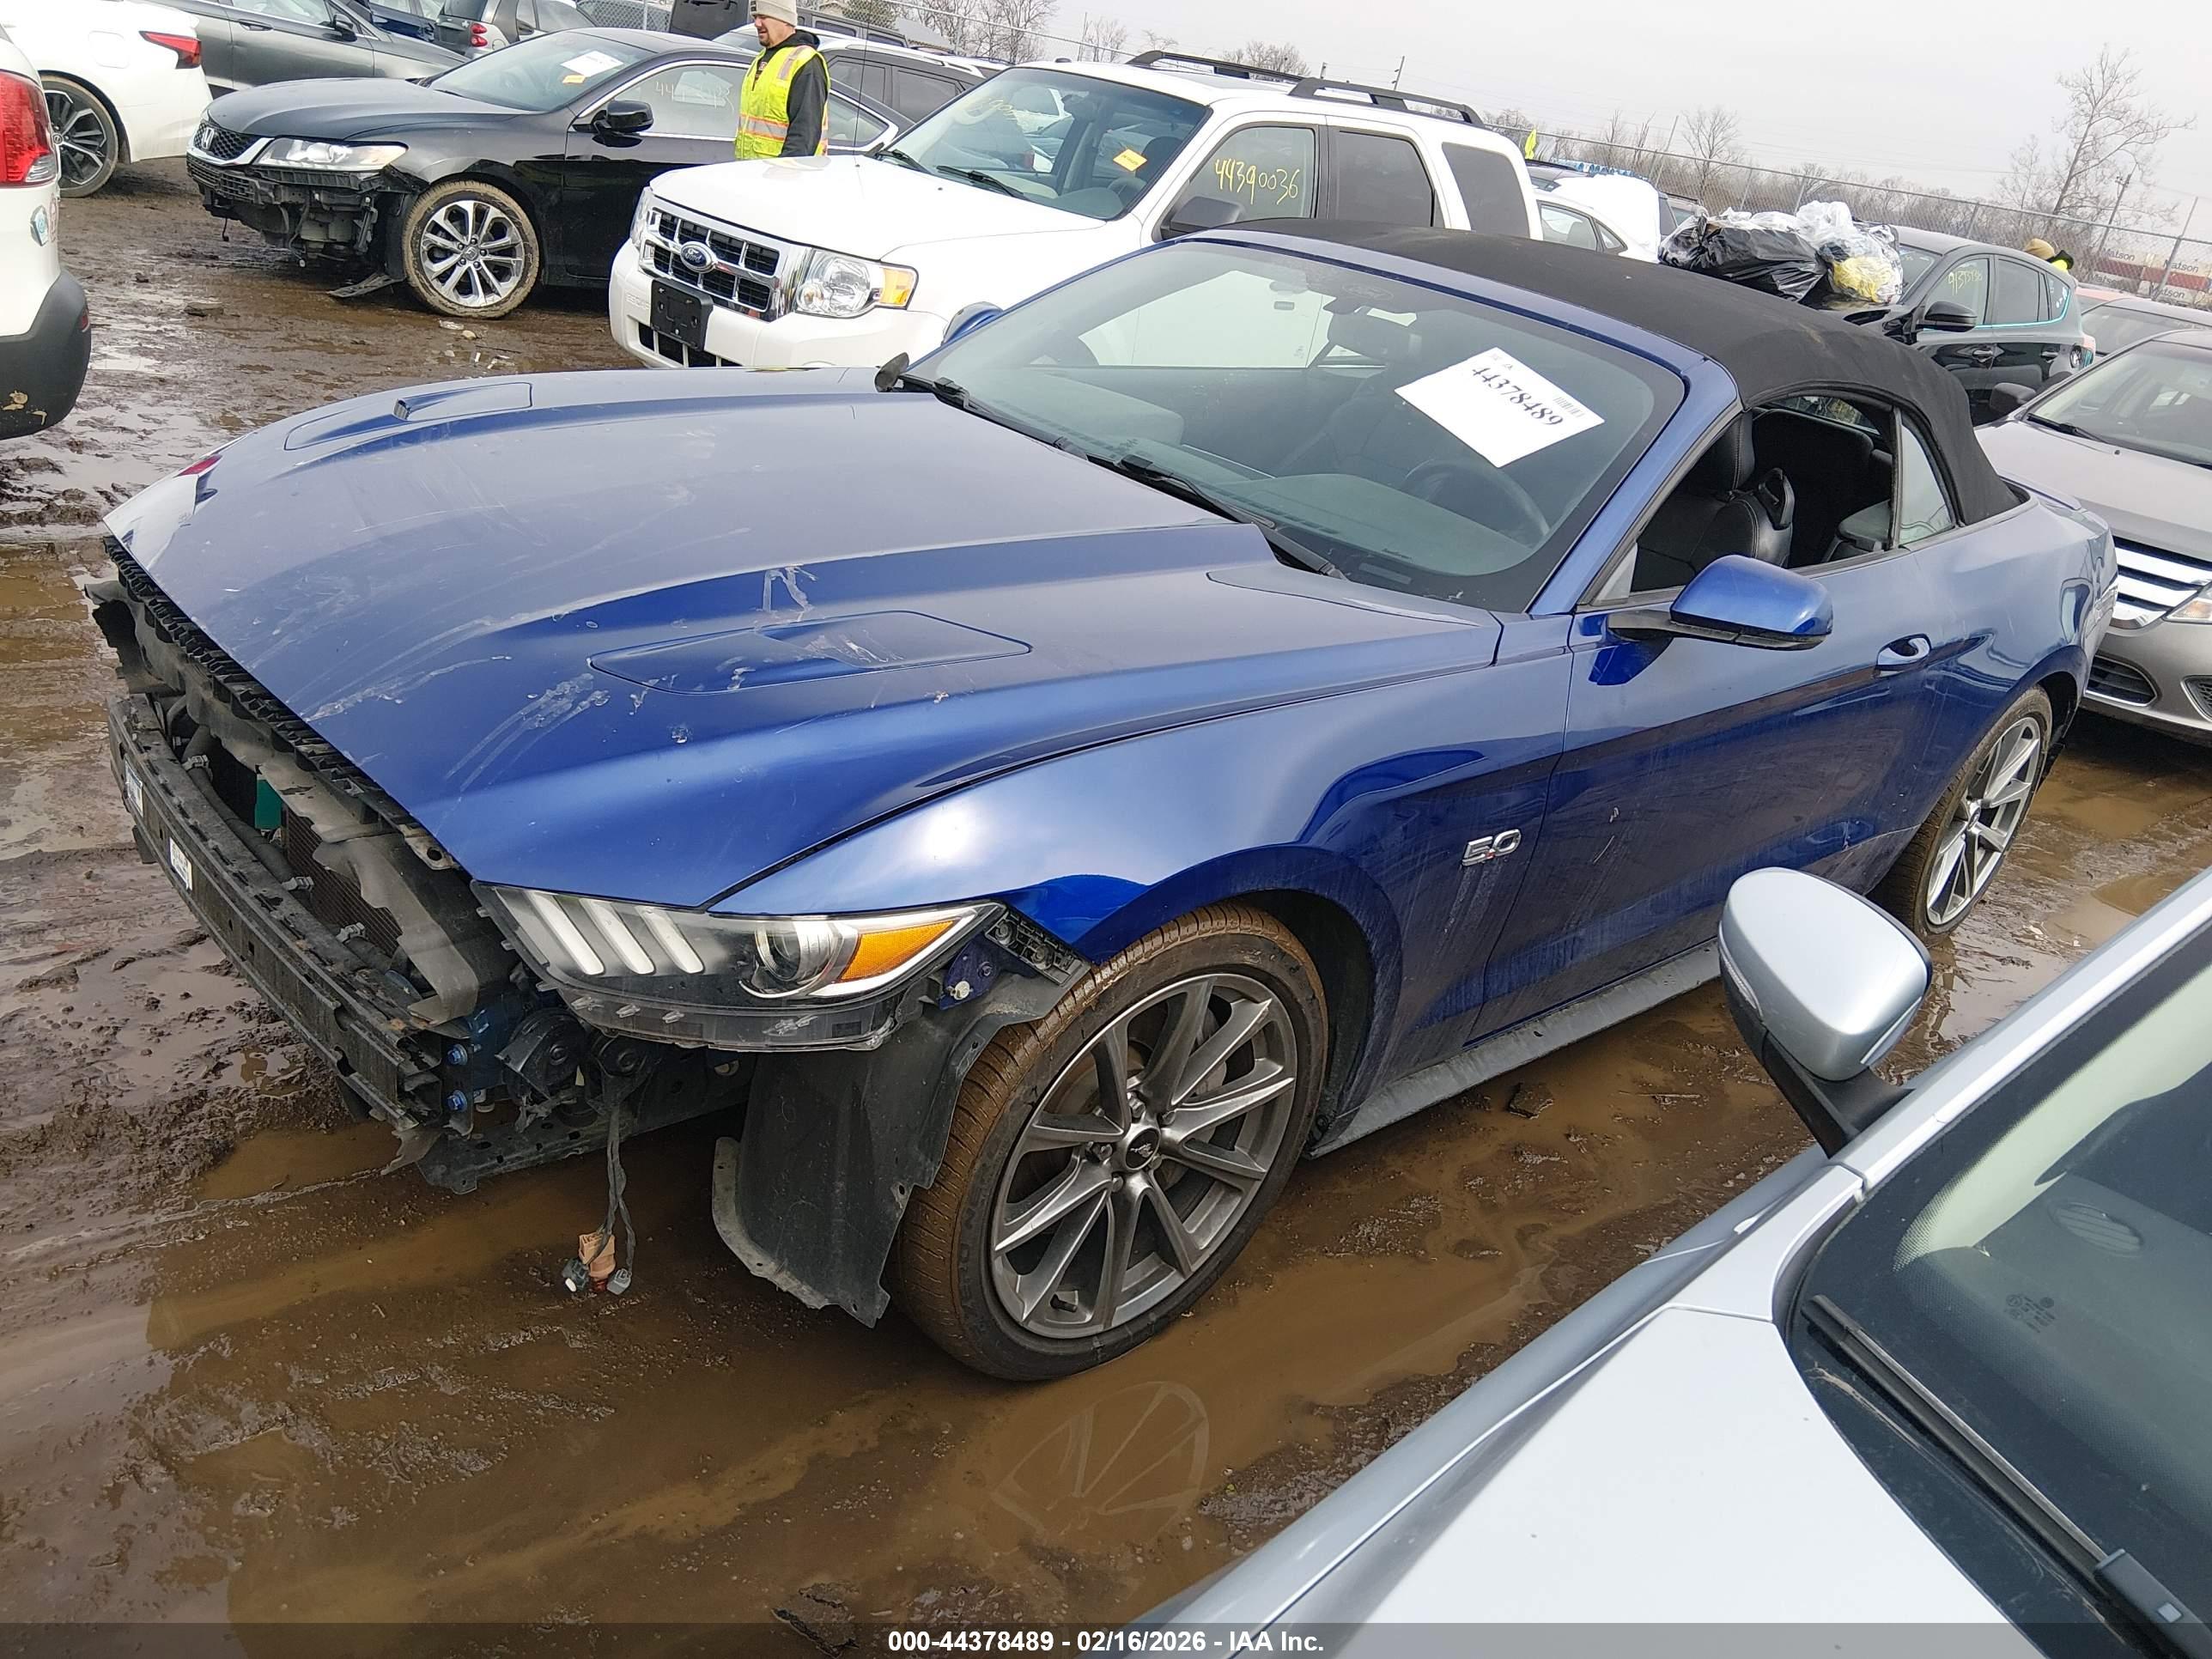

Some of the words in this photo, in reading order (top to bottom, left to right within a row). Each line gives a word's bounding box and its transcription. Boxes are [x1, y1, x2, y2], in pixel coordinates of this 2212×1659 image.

[1215, 158, 1300, 205] 44390036
[1471, 367, 1564, 425] 44378489
[1462, 829, 1522, 866] 5.0
